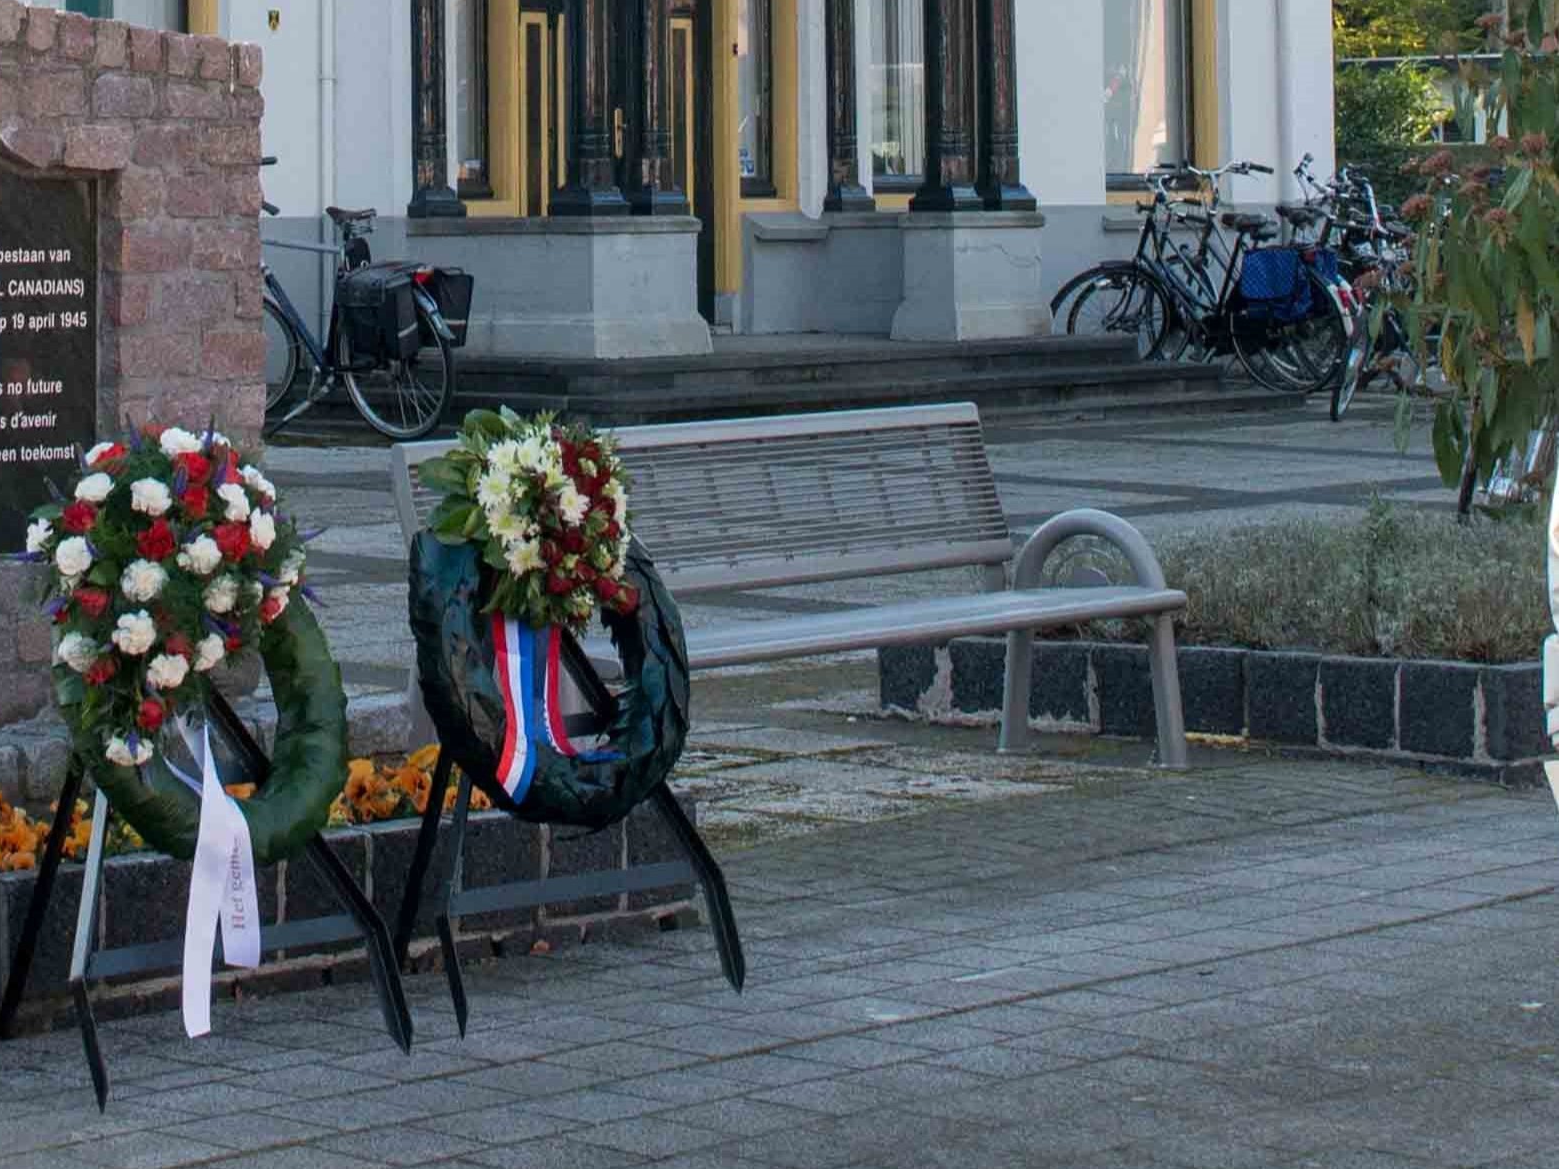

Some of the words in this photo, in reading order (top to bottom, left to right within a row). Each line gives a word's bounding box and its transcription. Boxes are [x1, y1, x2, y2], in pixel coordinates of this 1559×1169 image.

[49, 249, 71, 262] van
[8, 278, 85, 298] CANADIANS)
[12, 313, 25, 329] 19
[28, 312, 55, 332] april
[60, 311, 87, 328] 1945
[7, 382, 23, 395] no
[27, 378, 63, 395] future
[21, 444, 75, 461] toekomst
